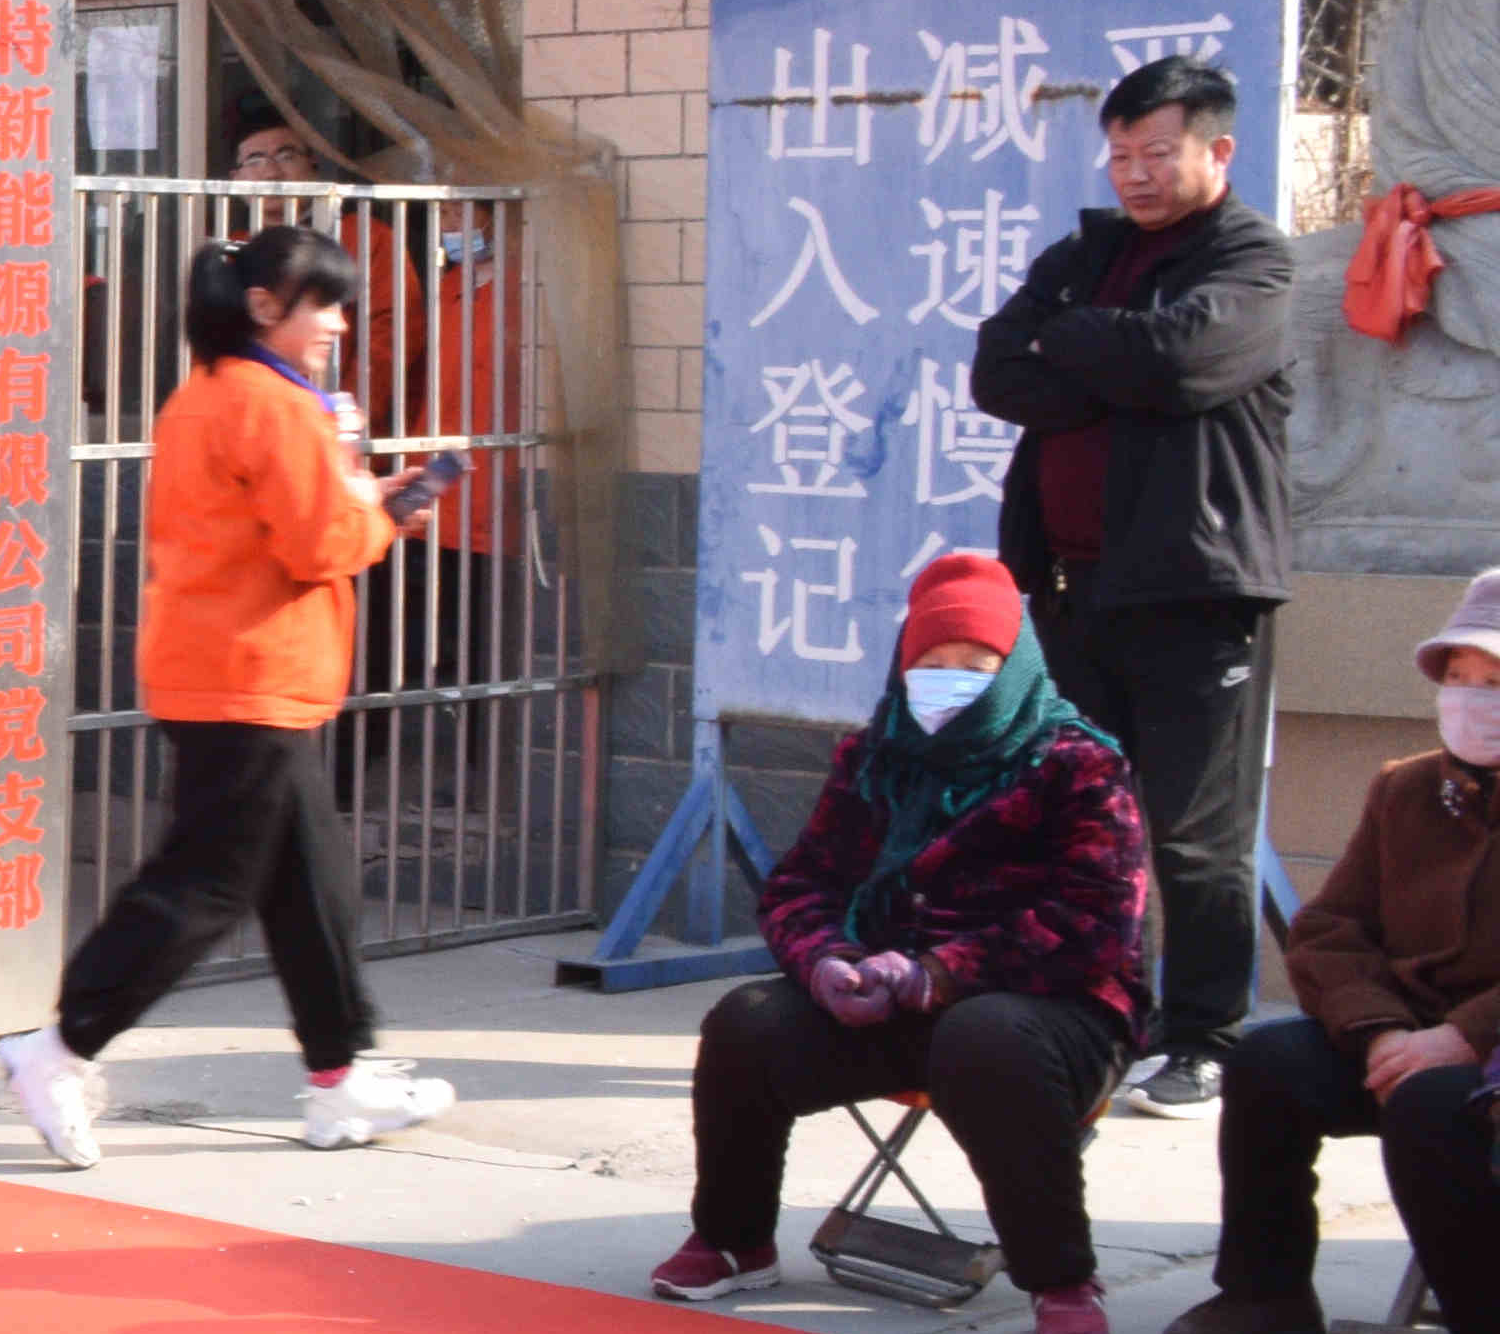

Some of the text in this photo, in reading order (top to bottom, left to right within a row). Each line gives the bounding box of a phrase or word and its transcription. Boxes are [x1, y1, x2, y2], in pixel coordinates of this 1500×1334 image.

[741, 27, 881, 663] 出入登记
[893, 16, 1050, 624] 减速慢
